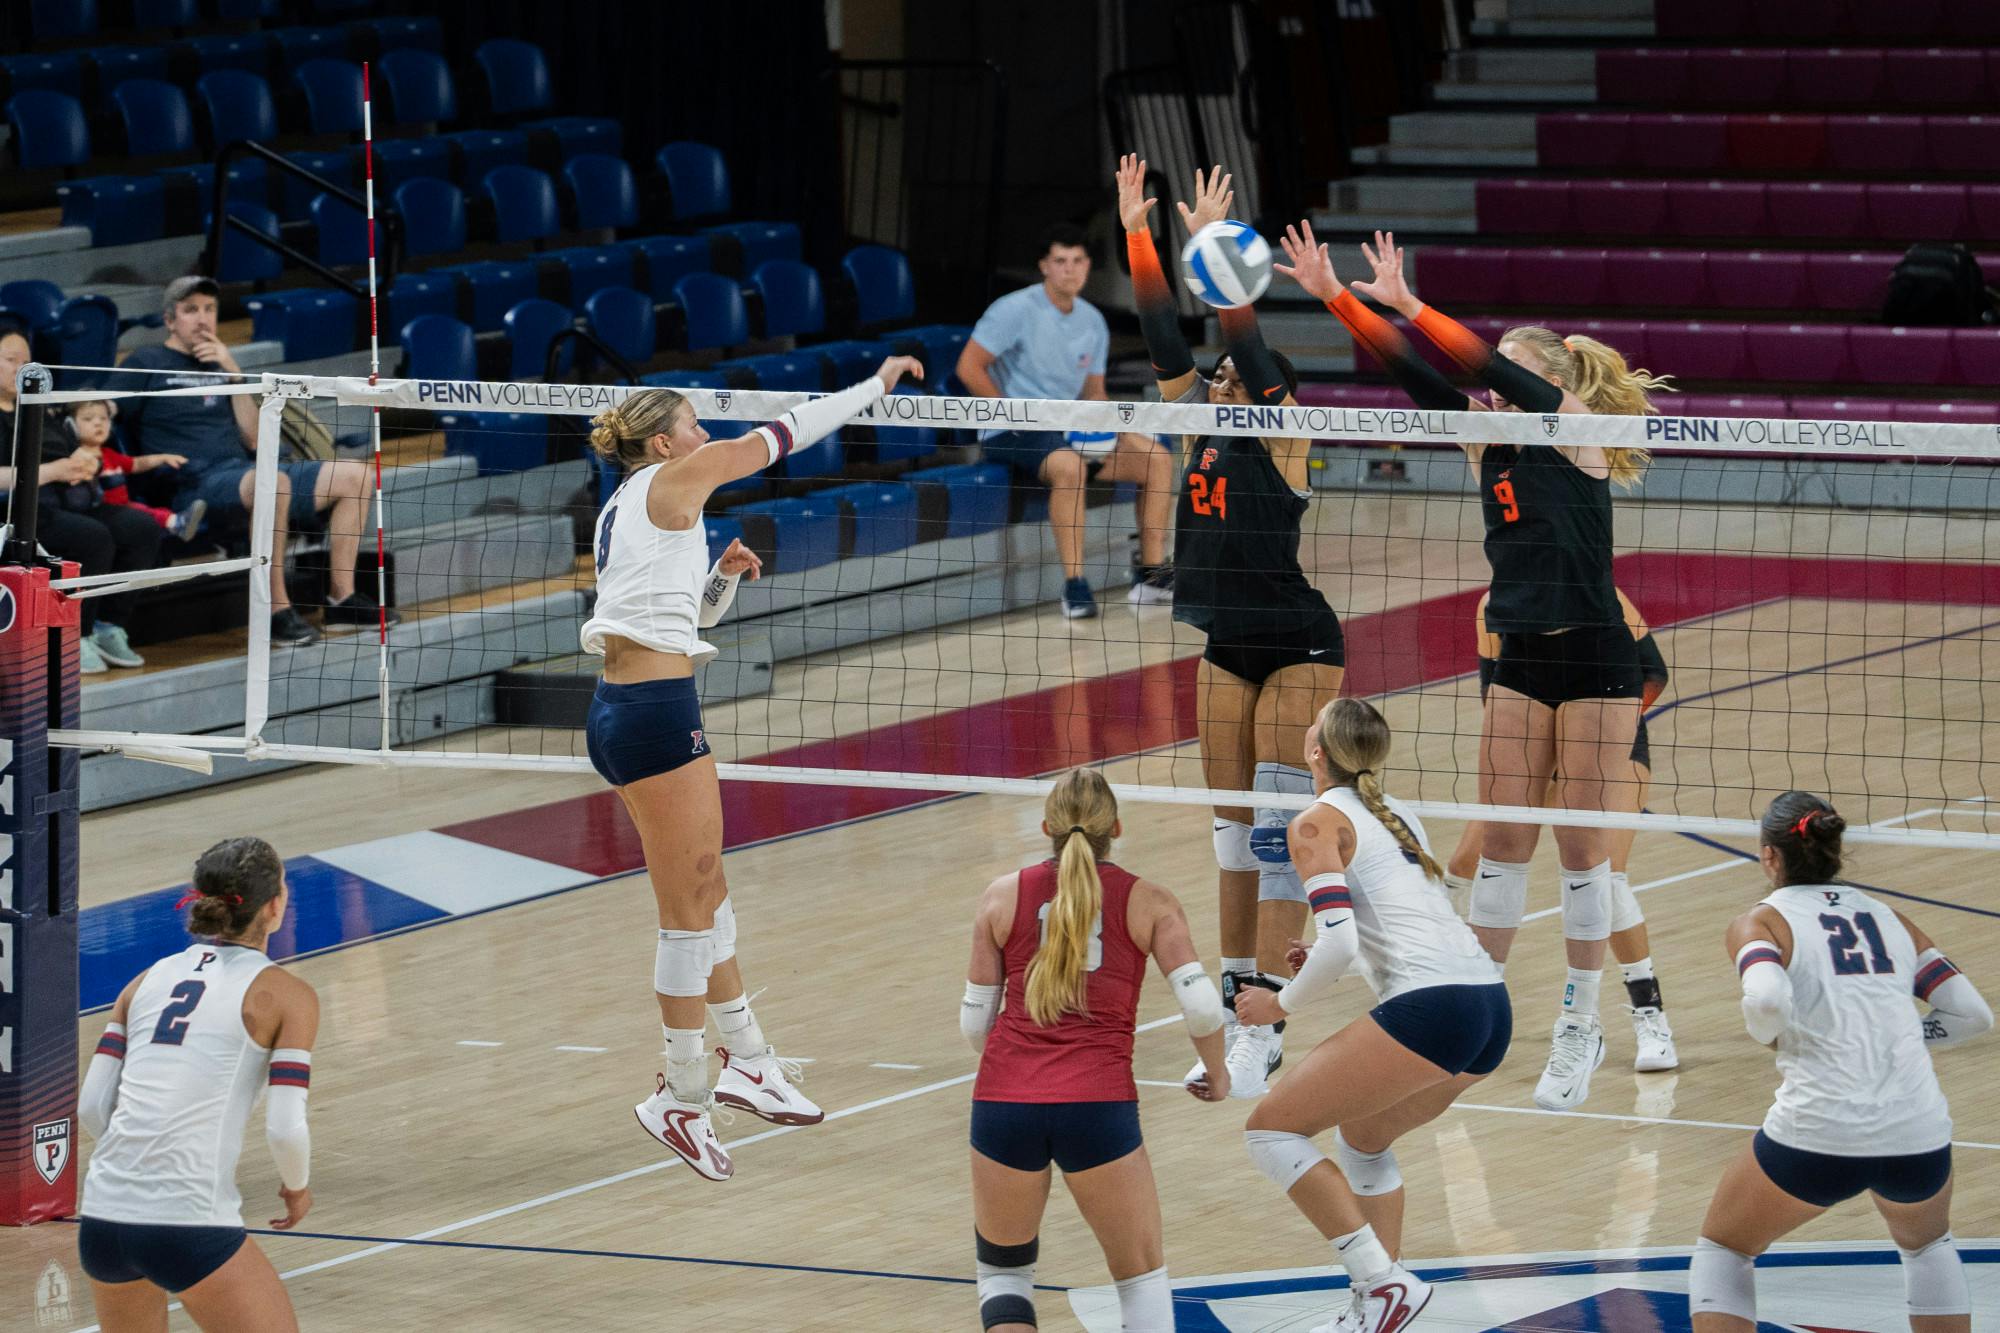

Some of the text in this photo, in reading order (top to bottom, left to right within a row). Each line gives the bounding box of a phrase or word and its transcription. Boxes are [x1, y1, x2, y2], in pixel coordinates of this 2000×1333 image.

[418, 381, 482, 404] PENN
[883, 397, 1038, 424] VOLLEYBALL
[1216, 406, 1458, 435] PENN VOLLEYBALL
[1646, 418, 1905, 447] PENN VOLLEYBALL
[1188, 473, 1228, 521] 24
[1493, 480, 1520, 523] 9
[1818, 911, 1895, 976] 21
[193, 952, 217, 972] P
[150, 979, 206, 1046] 2
[37, 1123, 67, 1140] PENN
[45, 1143, 60, 1171] P
